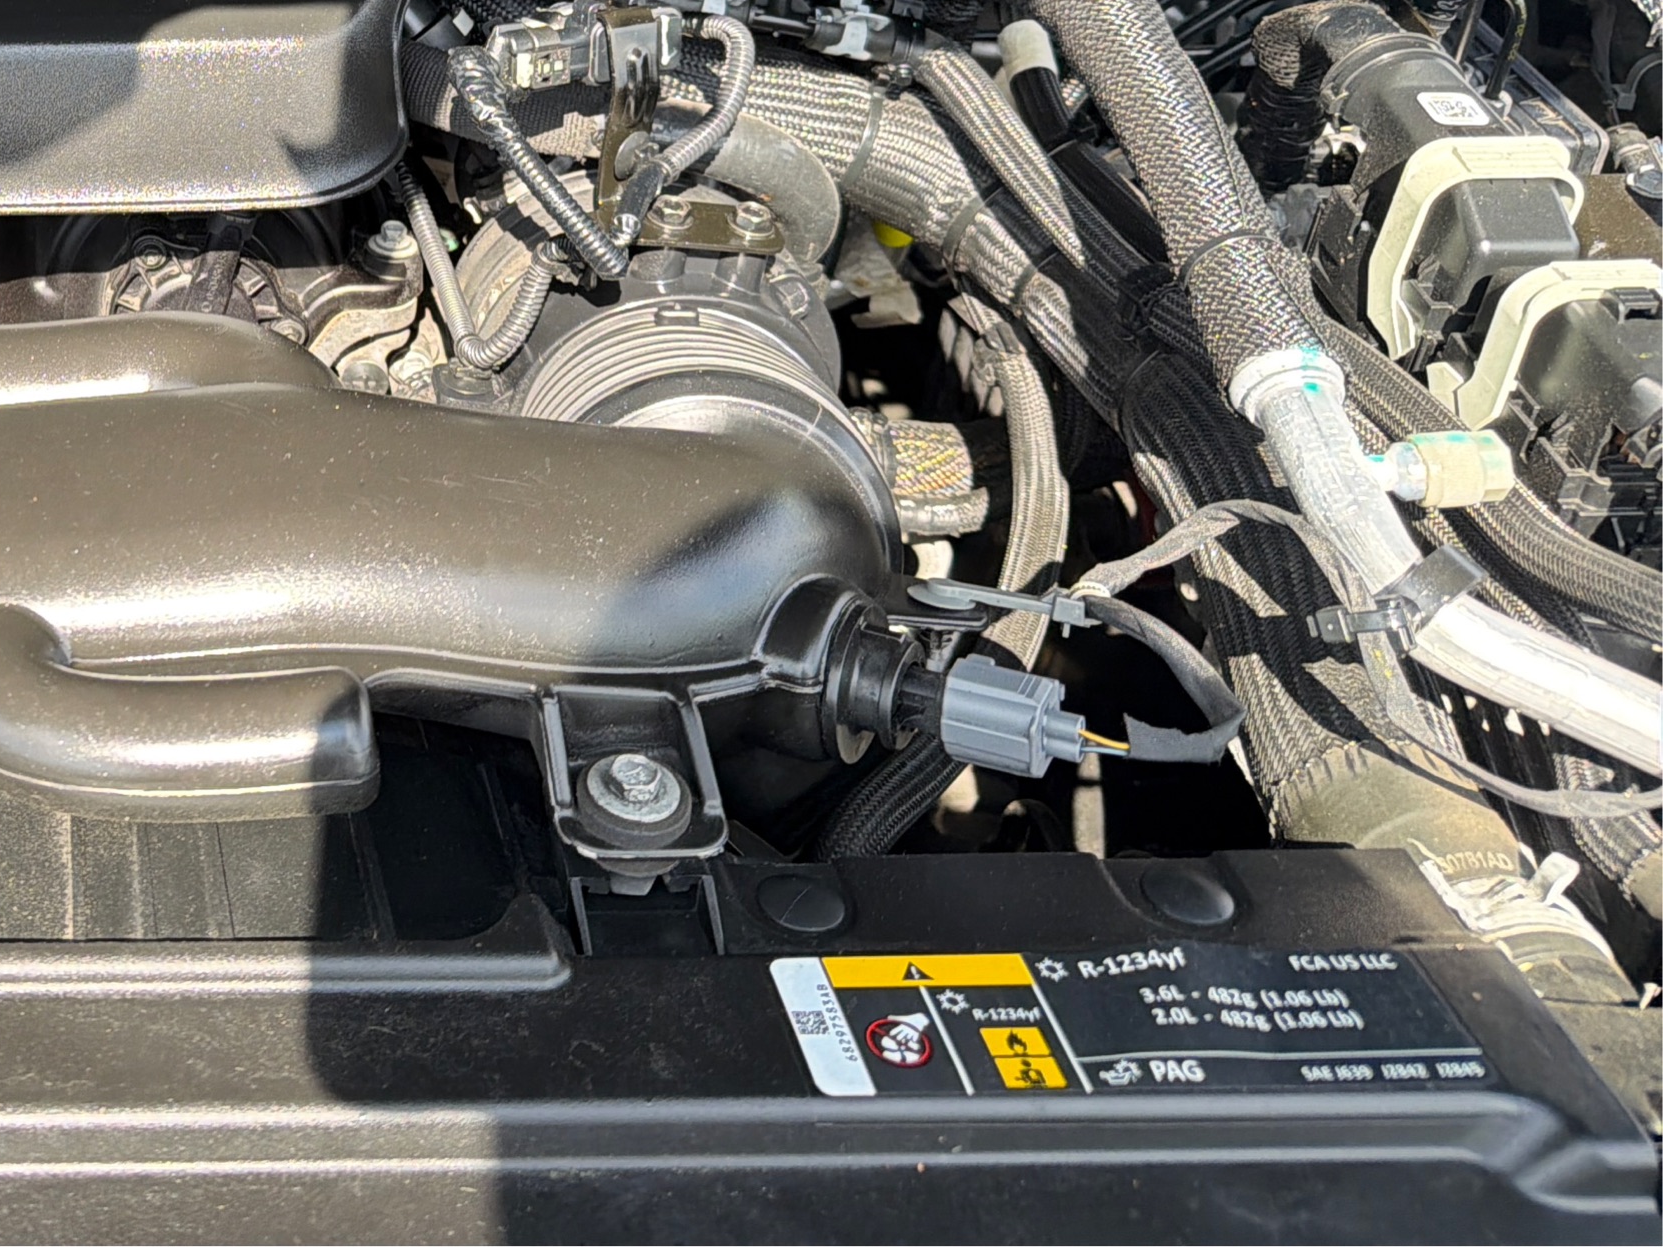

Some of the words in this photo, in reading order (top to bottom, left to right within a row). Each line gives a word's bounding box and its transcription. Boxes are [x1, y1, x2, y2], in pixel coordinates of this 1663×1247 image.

[1077, 946, 1186, 979] R-1234yf
[1288, 954, 1331, 972] FCA
[1329, 954, 1360, 971] US
[1359, 953, 1398, 971] LLC
[1139, 984, 1186, 1004] 3.6L
[1207, 986, 1258, 1010] 482g
[1260, 989, 1314, 1011] (1.06
[1312, 988, 1350, 1009] Lb)
[816, 983, 859, 1063] 68297583AB
[971, 1006, 1042, 1024] R-1234yf
[1151, 1006, 1199, 1026] 2.0L
[1220, 1008, 1272, 1032] 482g
[1273, 1011, 1328, 1032] (1.06
[1326, 1009, 1365, 1031] Lb)
[1149, 1059, 1206, 1082] PAG
[1300, 1064, 1335, 1082] SAE
